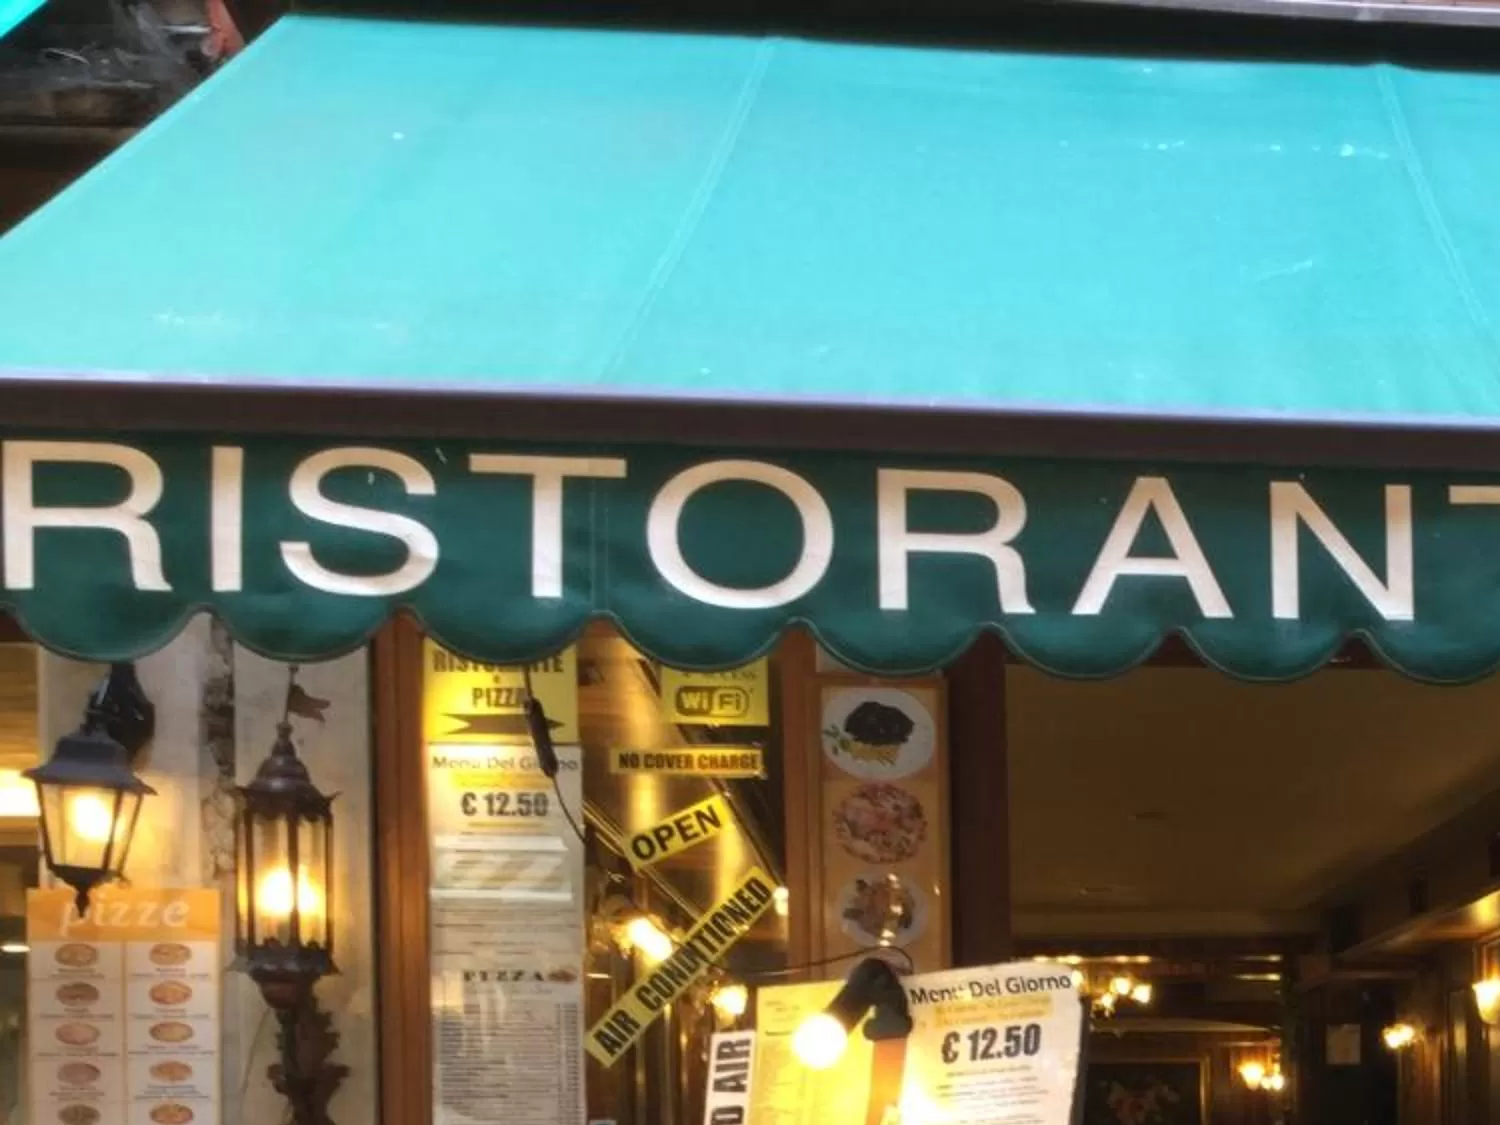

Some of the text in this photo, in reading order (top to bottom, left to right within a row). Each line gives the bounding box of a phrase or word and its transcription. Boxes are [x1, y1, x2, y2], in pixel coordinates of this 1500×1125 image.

[619, 753, 759, 770] NO COVER CHARGE
[483, 792, 549, 816] 12.50
[631, 804, 721, 861] OPEN
[593, 877, 772, 1057] AIR CONDITIONED
[969, 979, 1002, 997] Del
[1006, 975, 1072, 994] Giorno
[941, 1023, 1041, 1064] € 12.50
[712, 1038, 751, 1094] AIR
